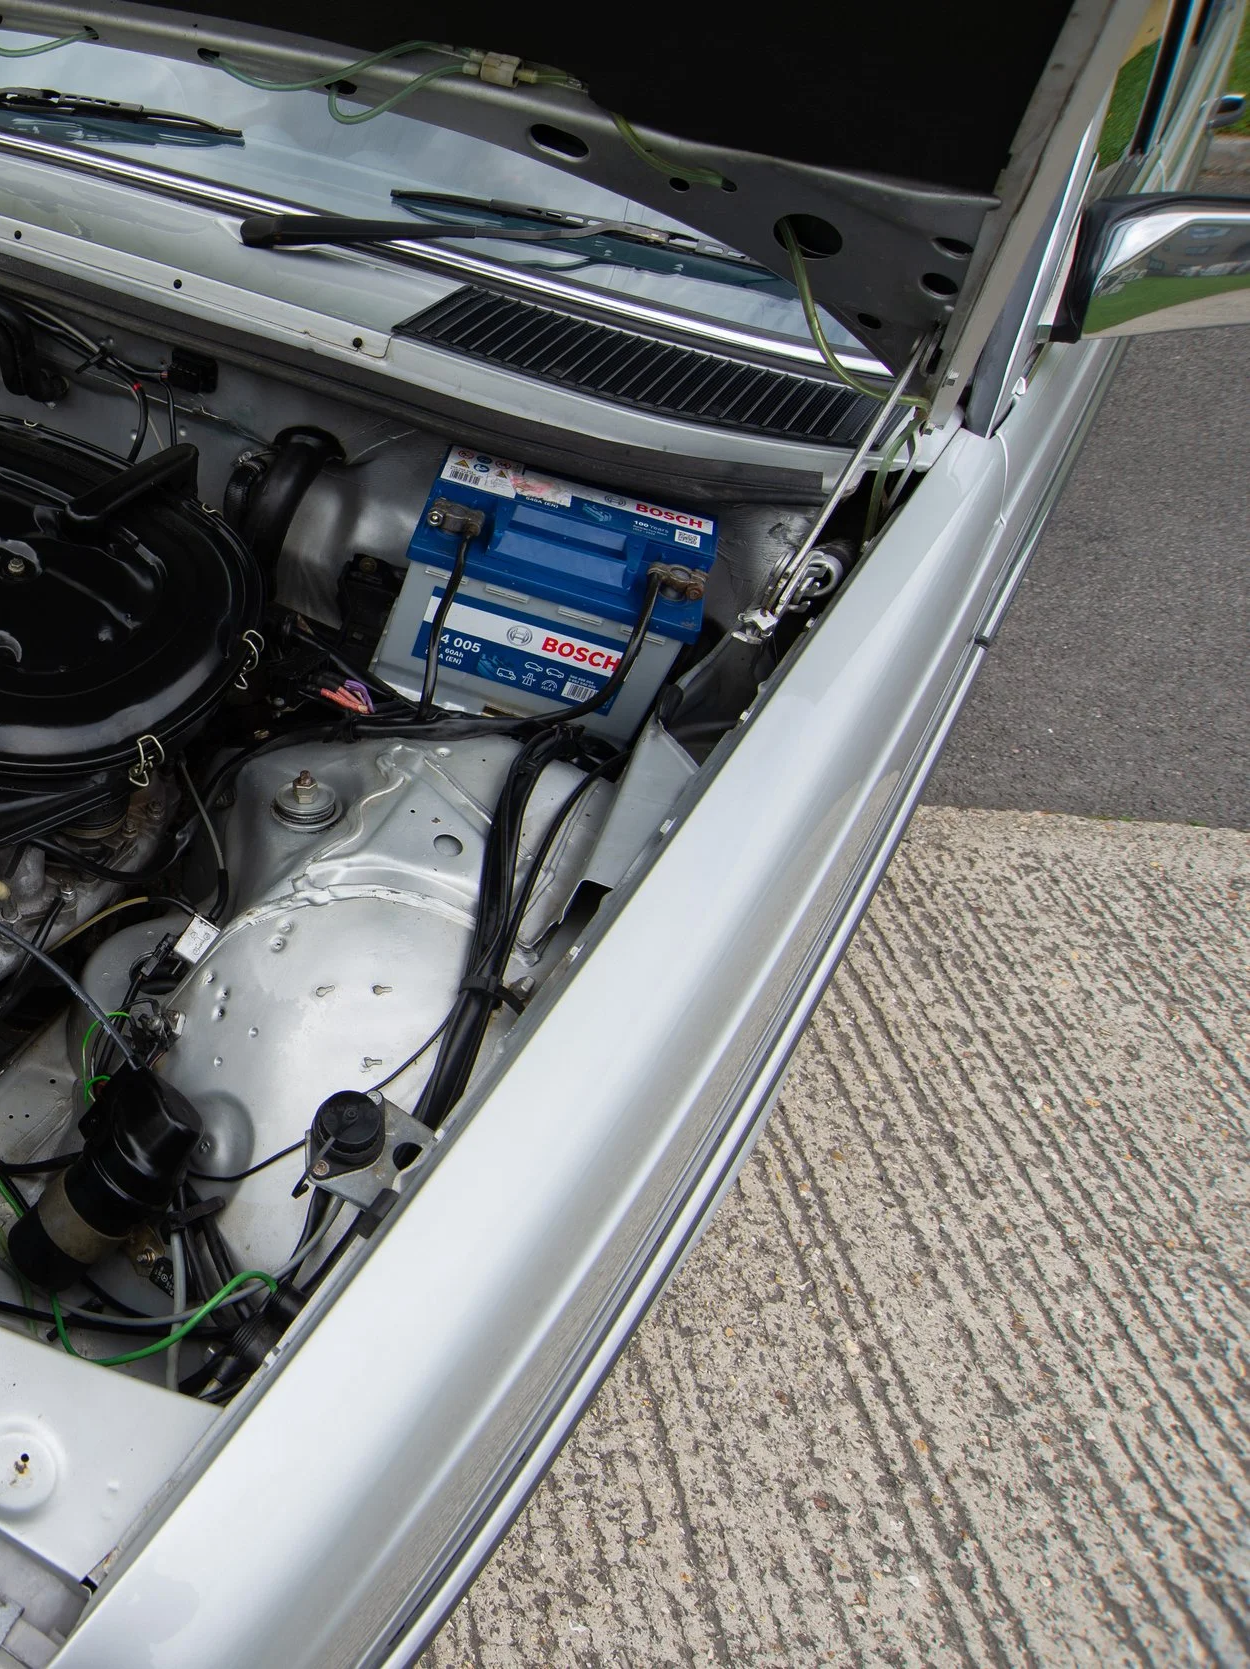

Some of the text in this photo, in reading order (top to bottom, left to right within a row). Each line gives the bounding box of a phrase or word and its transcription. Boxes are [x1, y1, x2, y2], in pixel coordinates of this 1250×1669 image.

[636, 504, 702, 528] BOSCH
[634, 520, 648, 528] 100
[454, 638, 482, 653] 005
[444, 648, 464, 658] 60Ah
[542, 636, 622, 672] BOSCH
[445, 655, 462, 665] (EN)
